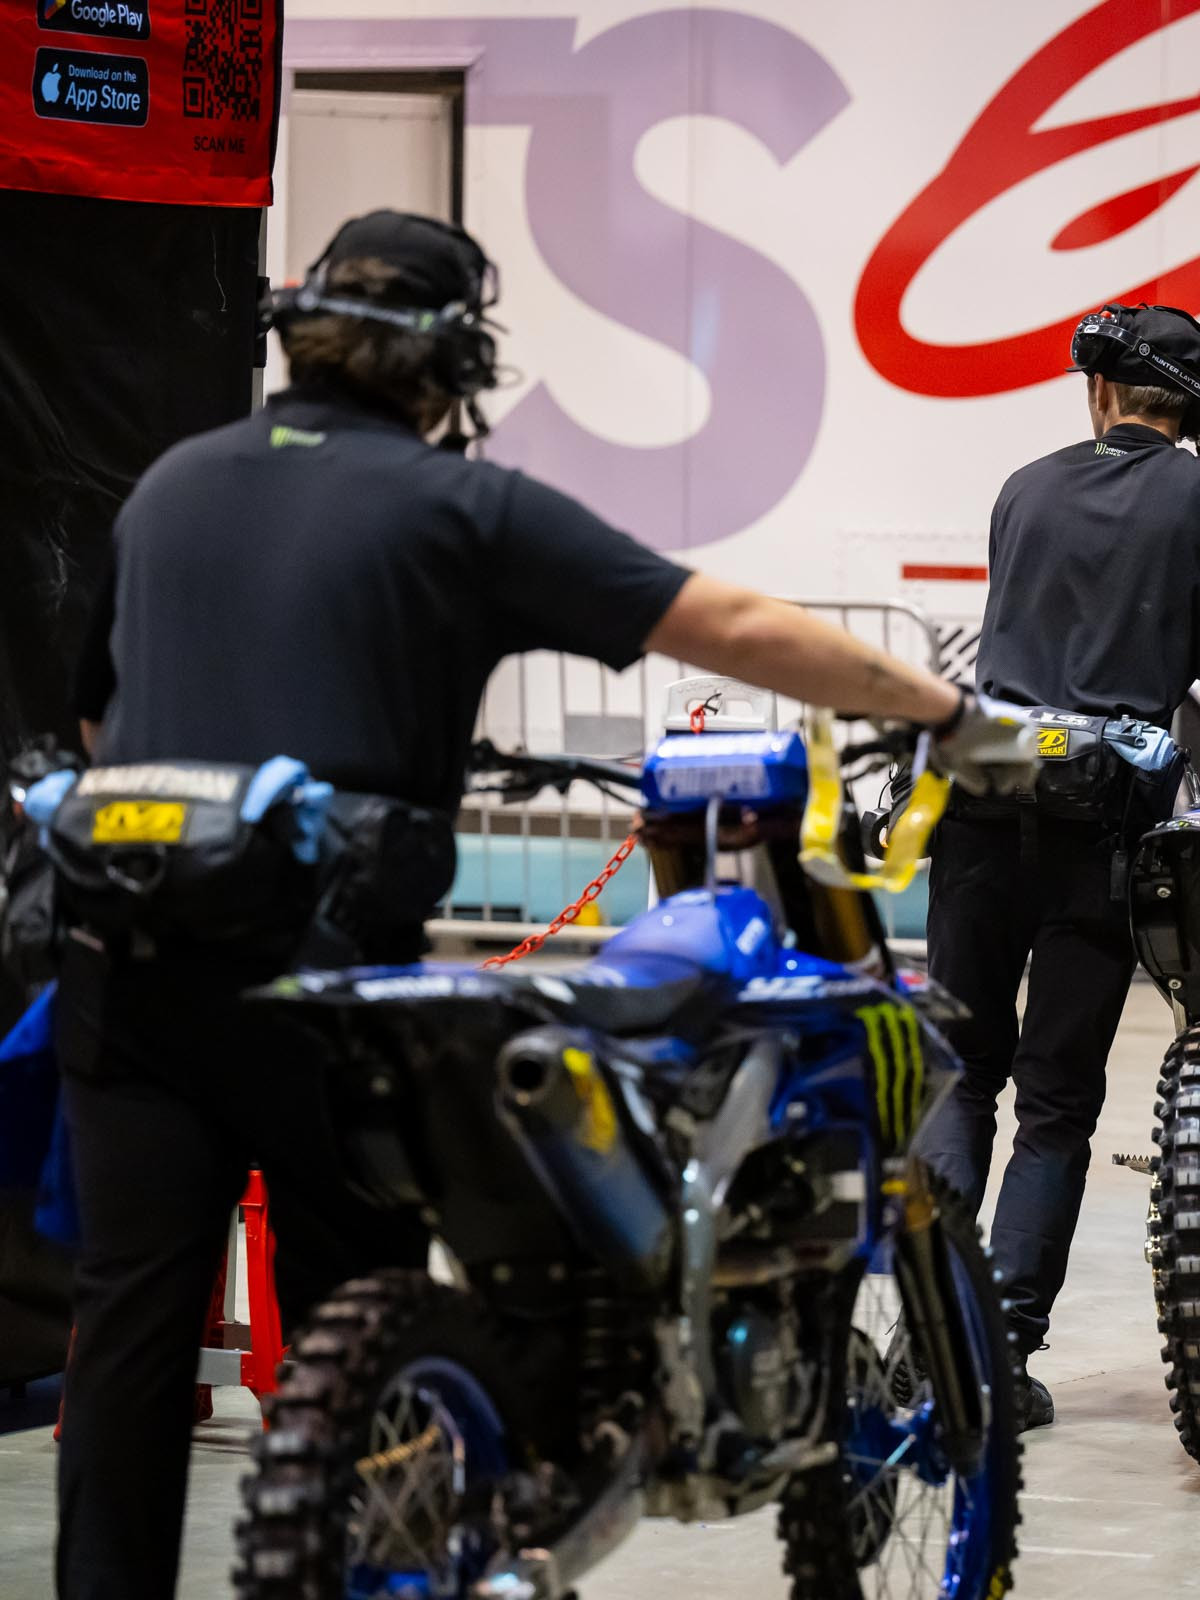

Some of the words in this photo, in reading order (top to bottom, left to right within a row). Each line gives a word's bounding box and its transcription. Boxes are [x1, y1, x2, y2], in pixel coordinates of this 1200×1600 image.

[71, 0, 116, 27] Google
[118, 4, 143, 32] Play
[68, 64, 110, 80] Download
[111, 71, 122, 81] on
[123, 70, 137, 83] the
[64, 84, 97, 112] App
[100, 85, 141, 111] Store
[193, 136, 225, 152] SCAN
[228, 138, 245, 154] ME
[1151, 354, 1179, 375] HUNTER
